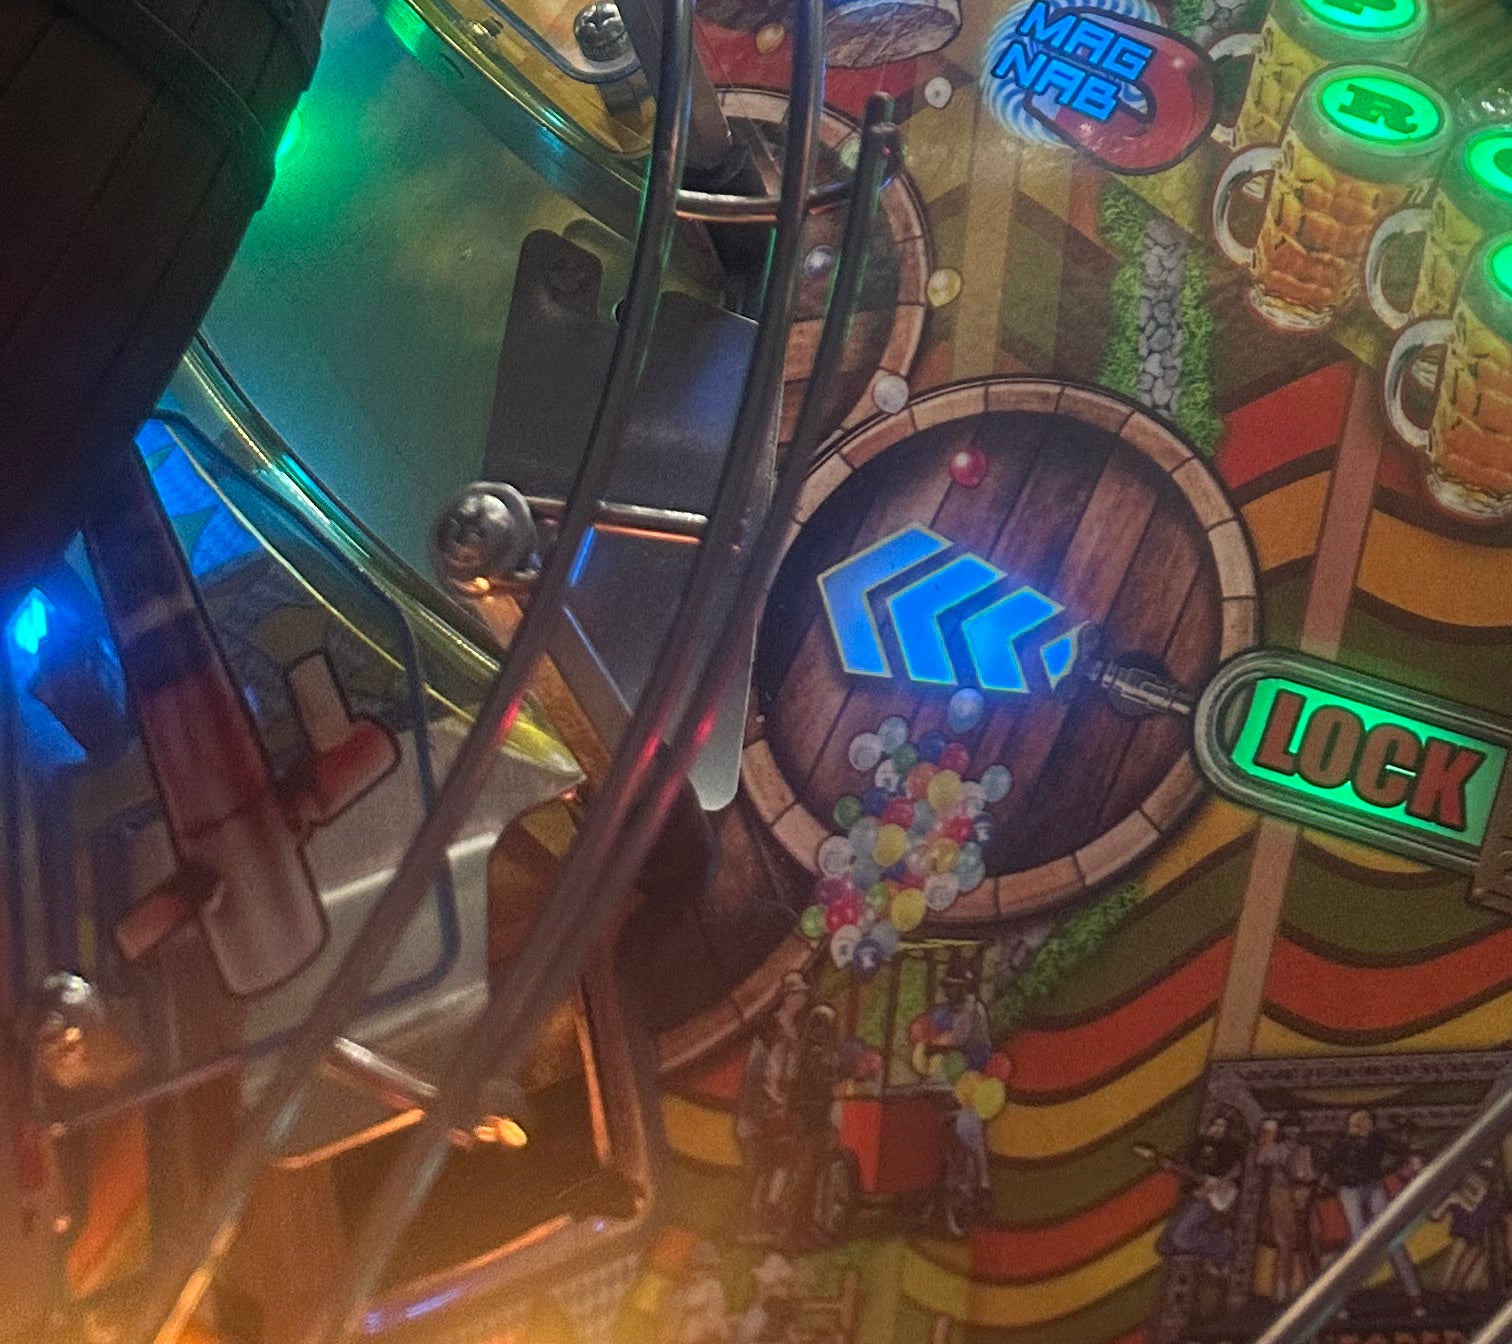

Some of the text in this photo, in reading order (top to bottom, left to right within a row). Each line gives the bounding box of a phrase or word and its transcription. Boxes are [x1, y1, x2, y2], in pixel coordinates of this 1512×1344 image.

[991, 40, 1120, 123] NAB
[1339, 84, 1418, 134] R
[1253, 689, 1487, 832] LOCK
